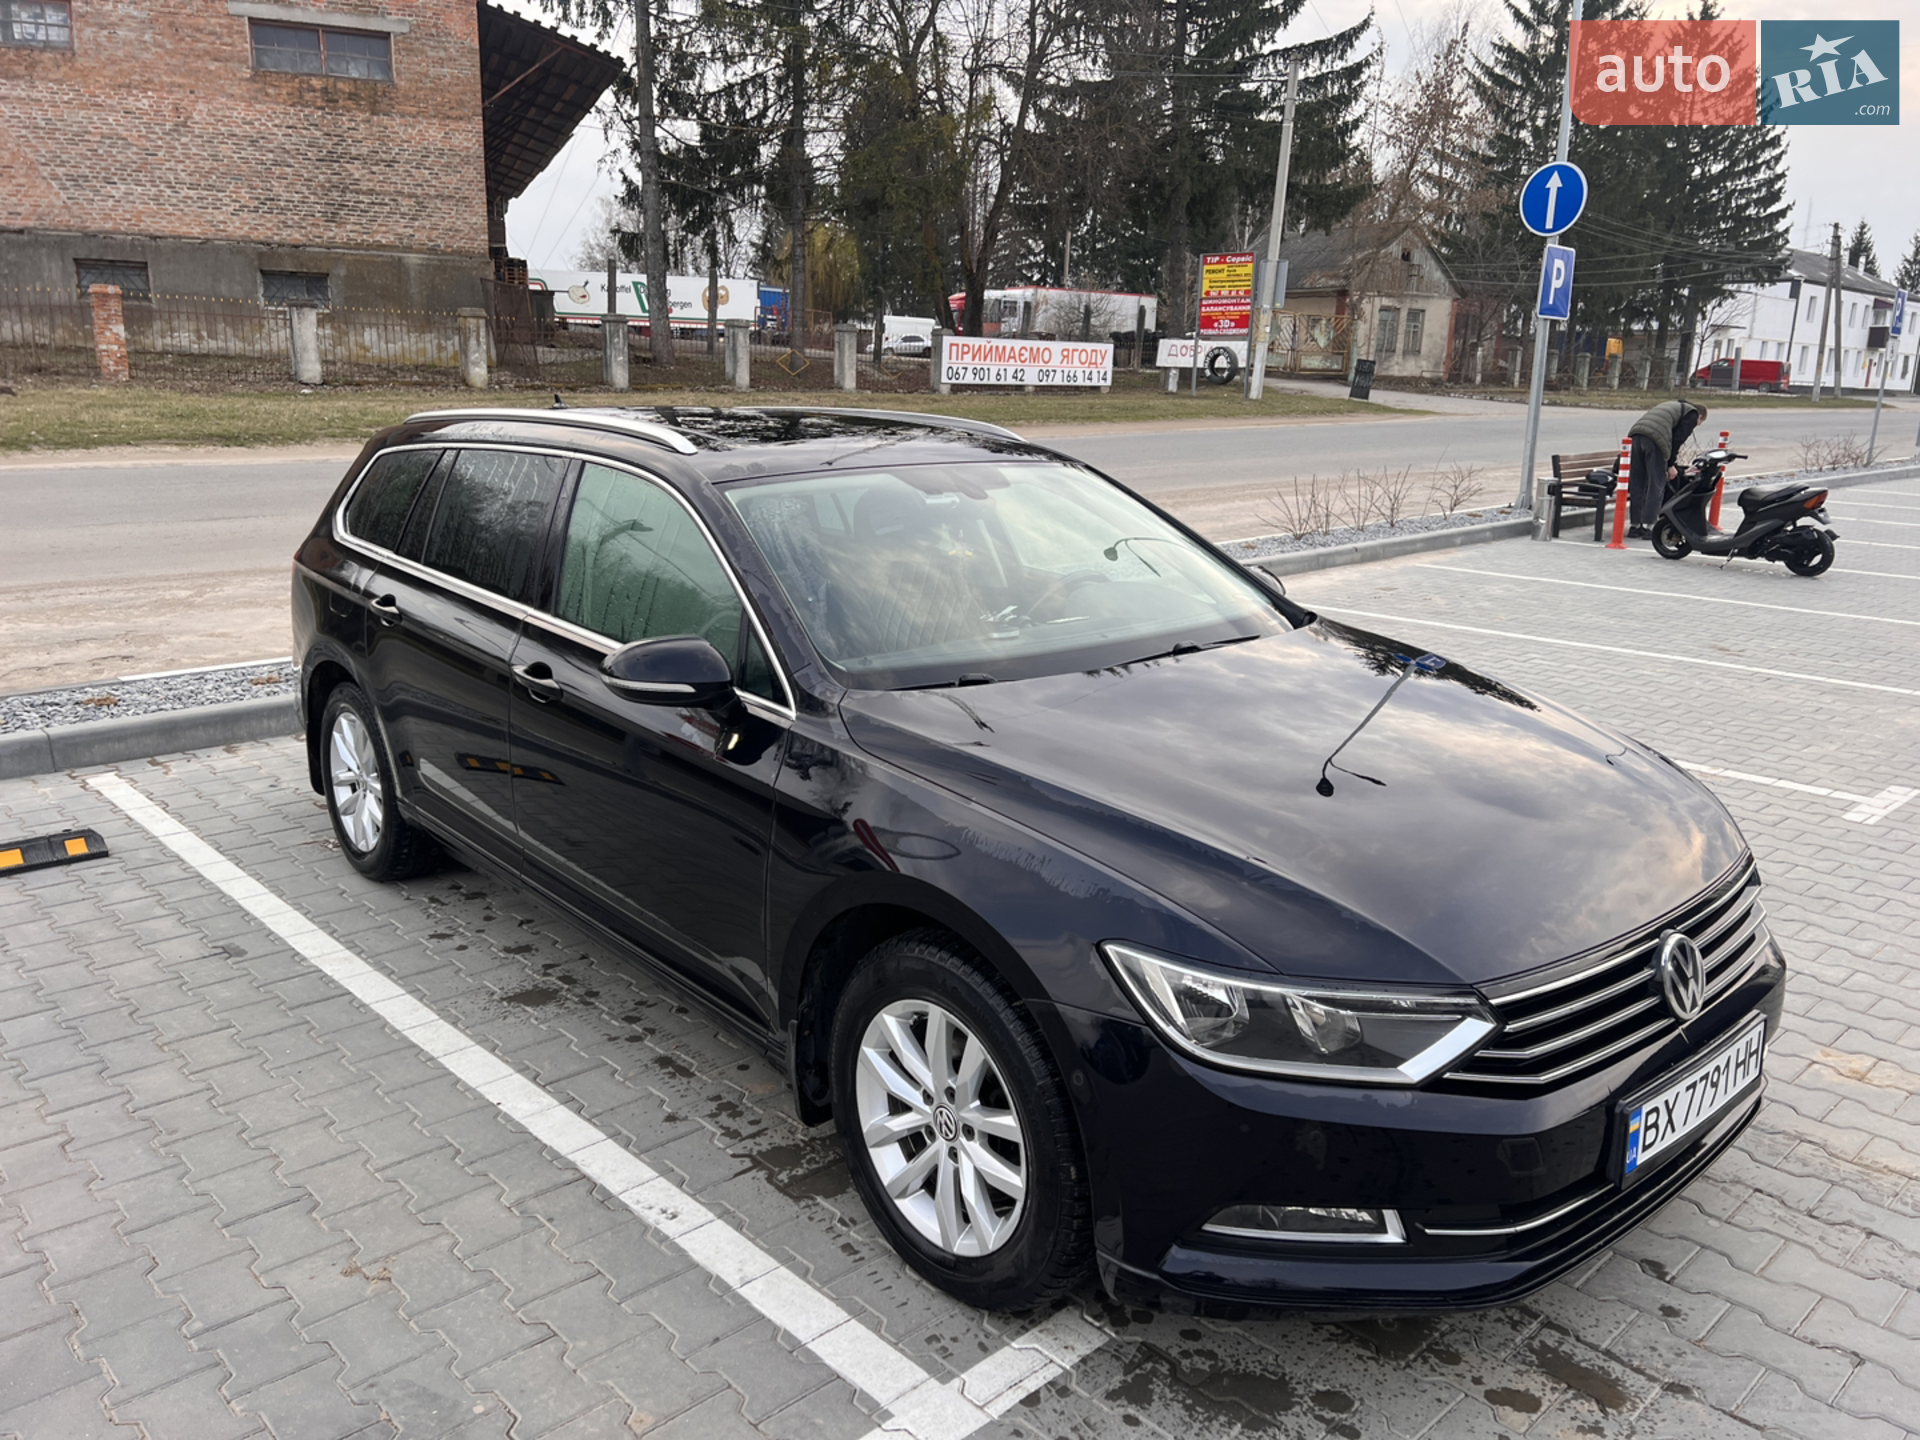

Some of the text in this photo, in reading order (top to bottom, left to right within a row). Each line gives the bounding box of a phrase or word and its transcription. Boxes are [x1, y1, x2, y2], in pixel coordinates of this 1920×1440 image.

[601, 284, 631, 294] Kaoffel
[1549, 258, 1566, 305] P
[949, 340, 1108, 369] ПРИЙМАЄМО ЯГОДУ
[946, 366, 1108, 383] 067 901 61 42 097 166 14 14
[1625, 1146, 1638, 1164] UA
